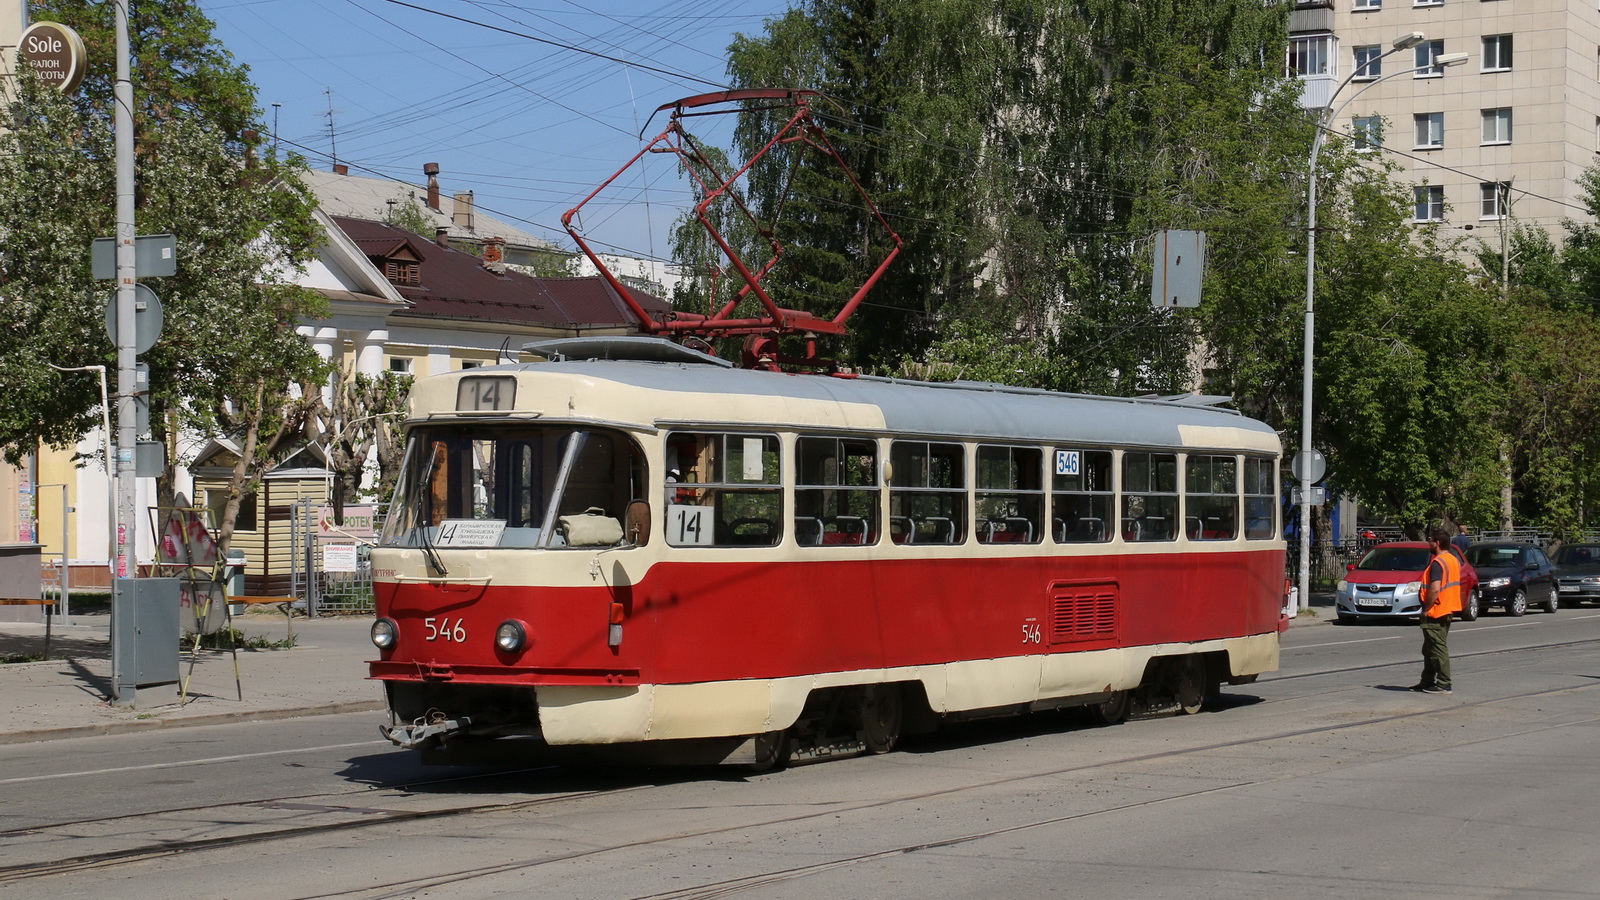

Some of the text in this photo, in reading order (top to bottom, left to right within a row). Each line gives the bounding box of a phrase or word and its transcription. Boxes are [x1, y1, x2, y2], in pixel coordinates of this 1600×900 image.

[28, 36, 62, 53] Sole
[470, 381, 501, 411] 14
[1058, 452, 1078, 473] 546
[436, 523, 458, 545] 14
[677, 509, 702, 543] 14
[425, 617, 466, 643] 546
[1022, 624, 1041, 644] 546
